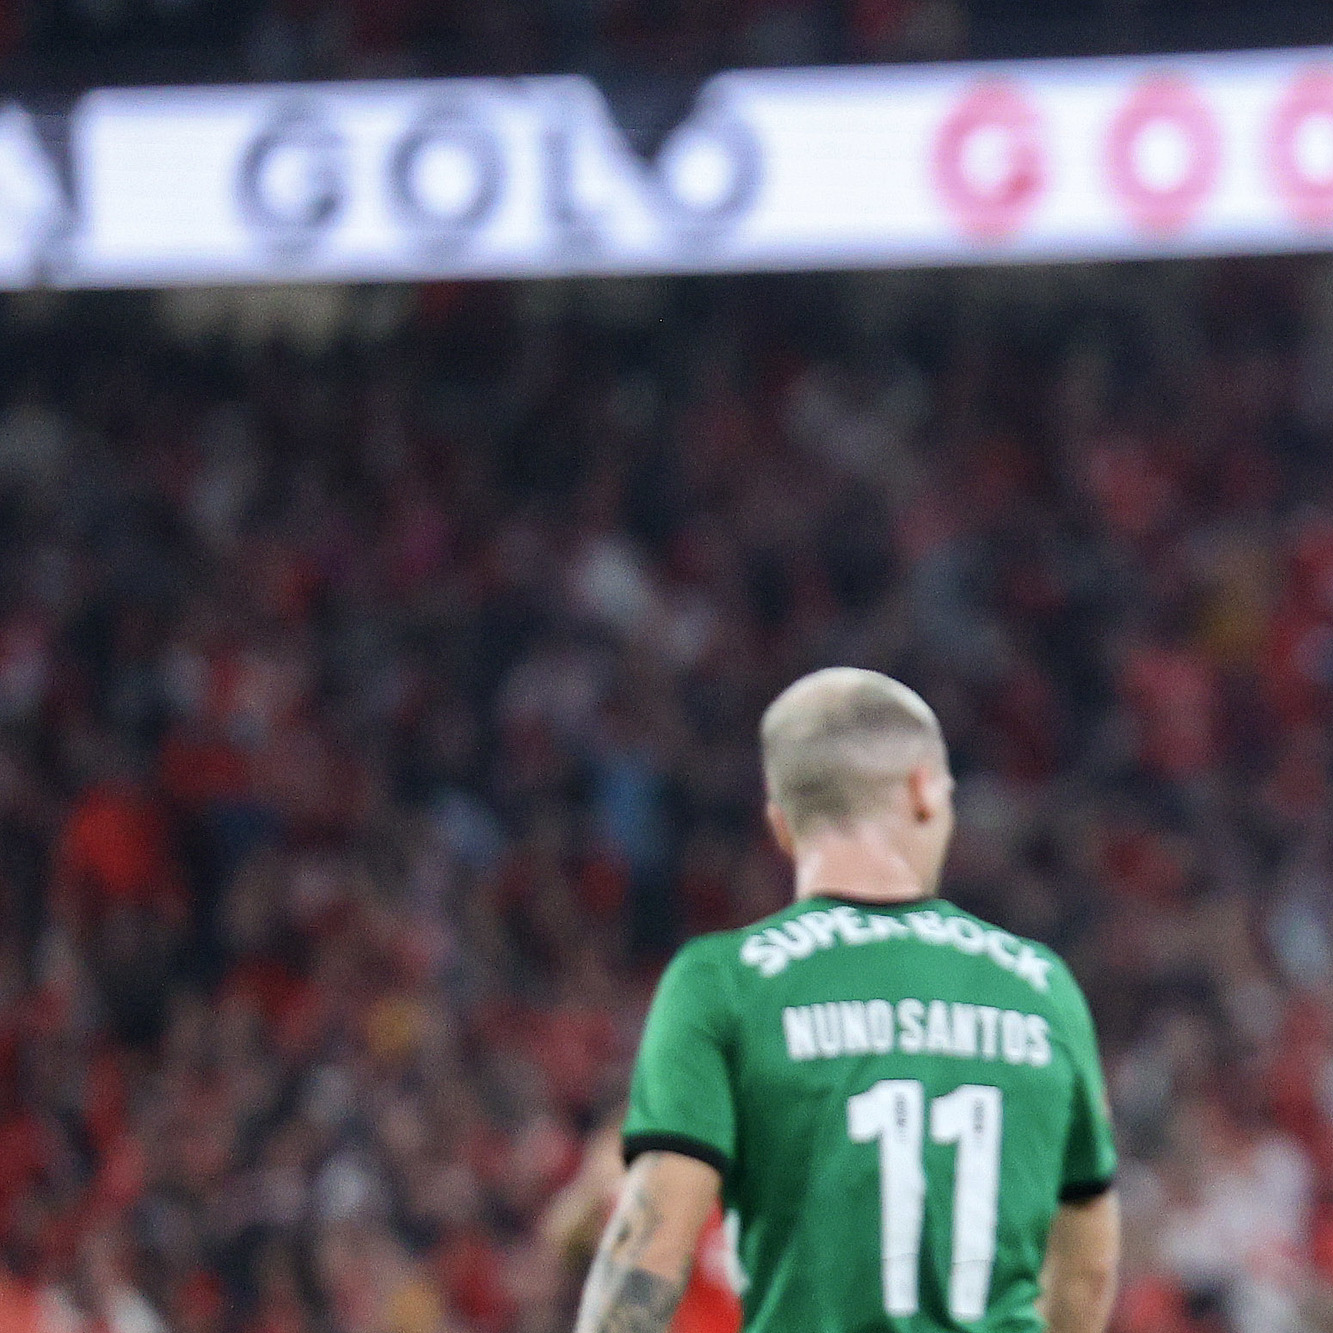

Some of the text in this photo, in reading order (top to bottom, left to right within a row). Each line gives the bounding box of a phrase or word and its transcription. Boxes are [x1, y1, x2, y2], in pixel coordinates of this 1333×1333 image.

[739, 905, 1050, 993] SUPER BOCK
[782, 997, 1051, 1068] NUNO SANTOS
[847, 1078, 1002, 1322] 11
